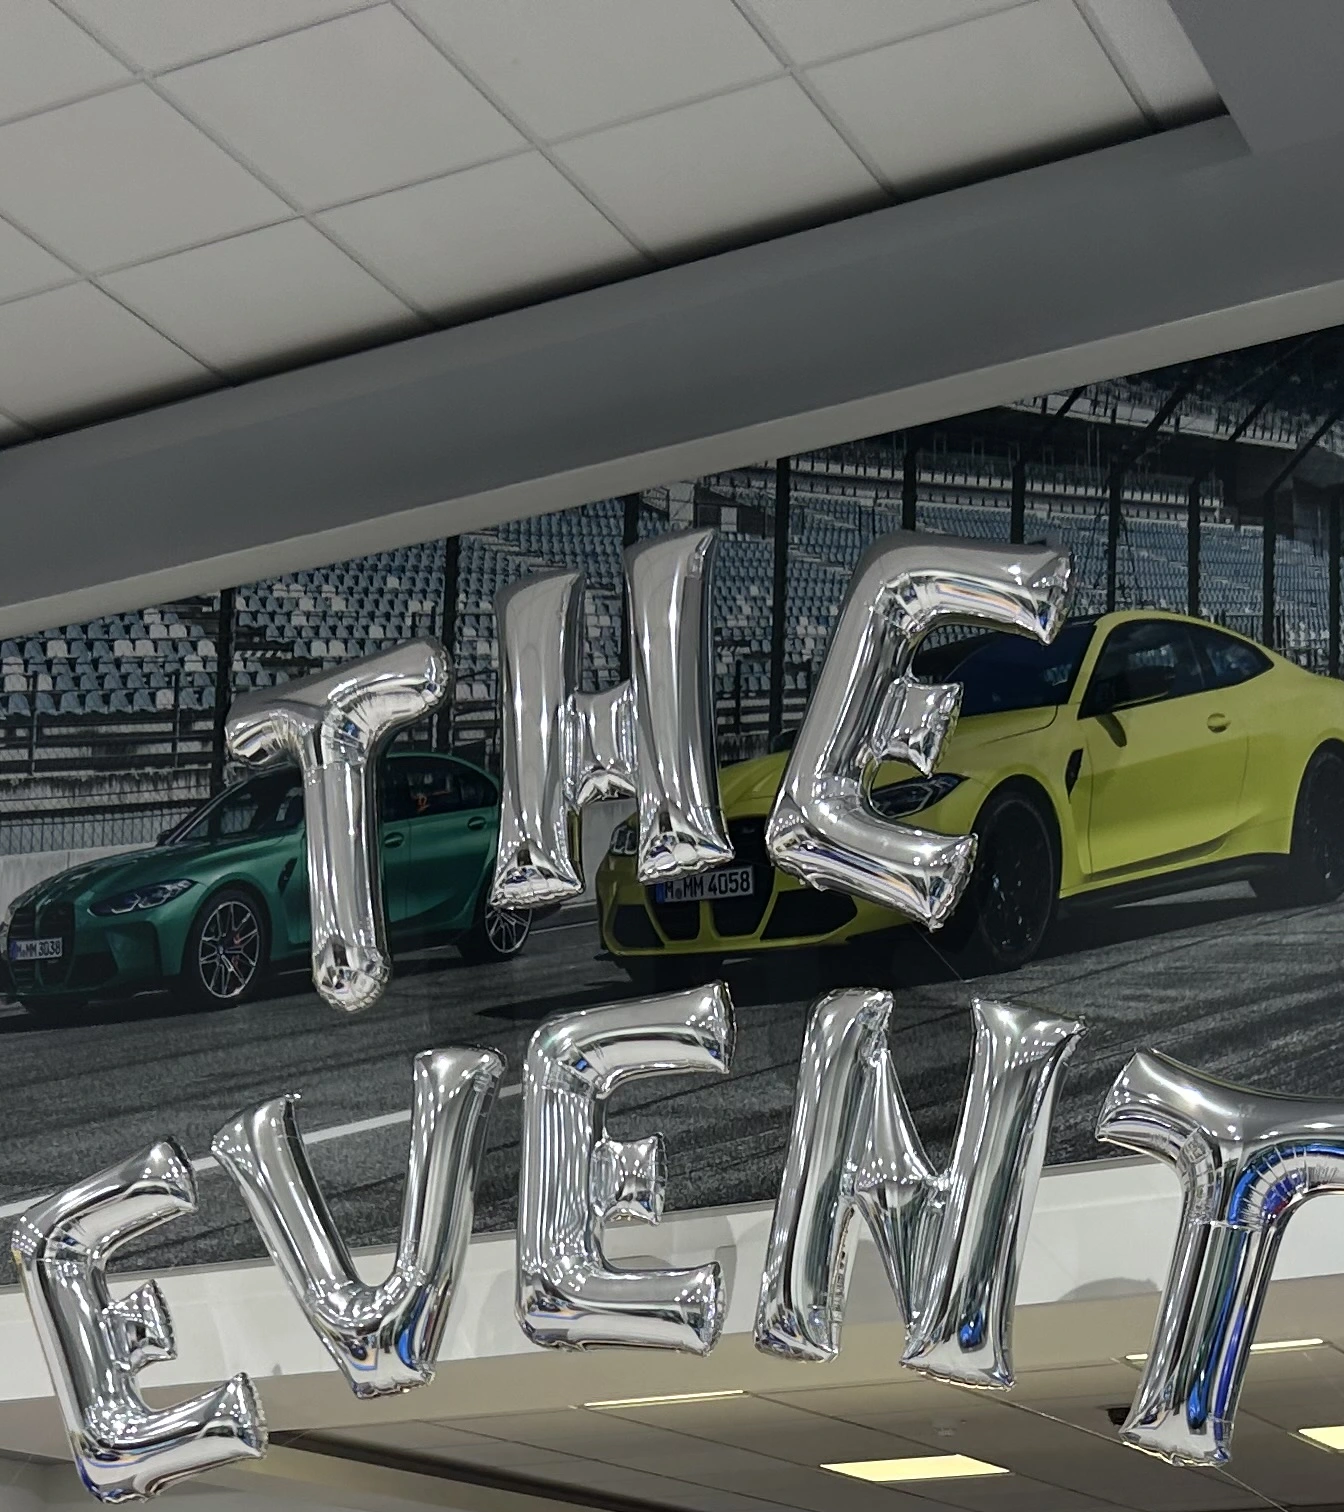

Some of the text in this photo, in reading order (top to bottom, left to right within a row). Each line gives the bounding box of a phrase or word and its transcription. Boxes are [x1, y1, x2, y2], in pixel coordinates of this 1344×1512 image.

[224, 527, 1074, 1010] THE
[684, 879, 704, 897] MM
[708, 870, 750, 895] 4058
